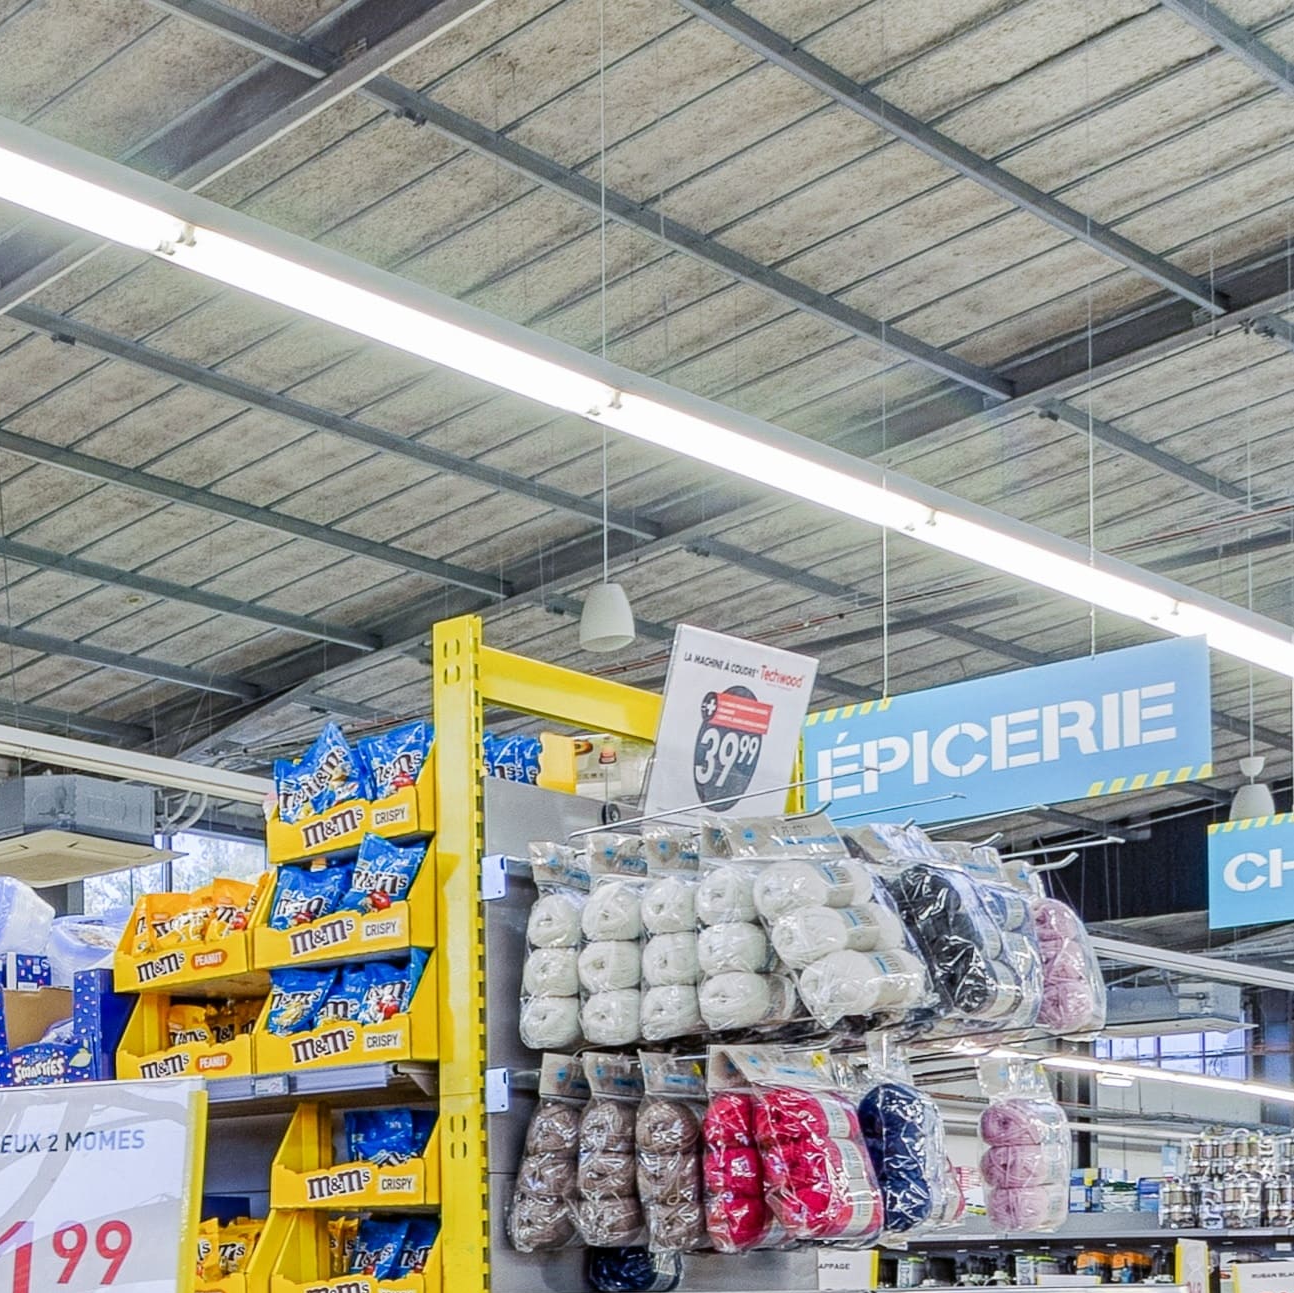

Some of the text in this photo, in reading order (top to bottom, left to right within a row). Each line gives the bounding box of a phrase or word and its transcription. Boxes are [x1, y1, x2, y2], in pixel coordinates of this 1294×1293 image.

[816, 680, 1177, 802] ÉPICERIE
[374, 807, 406, 825] CRISPY
[364, 920, 397, 938] CRISPY
[365, 1032, 398, 1049] CRISPY
[46, 1133, 58, 1153] 2
[65, 1129, 145, 1153] MOMES
[381, 1177, 413, 1191] CRISPY
